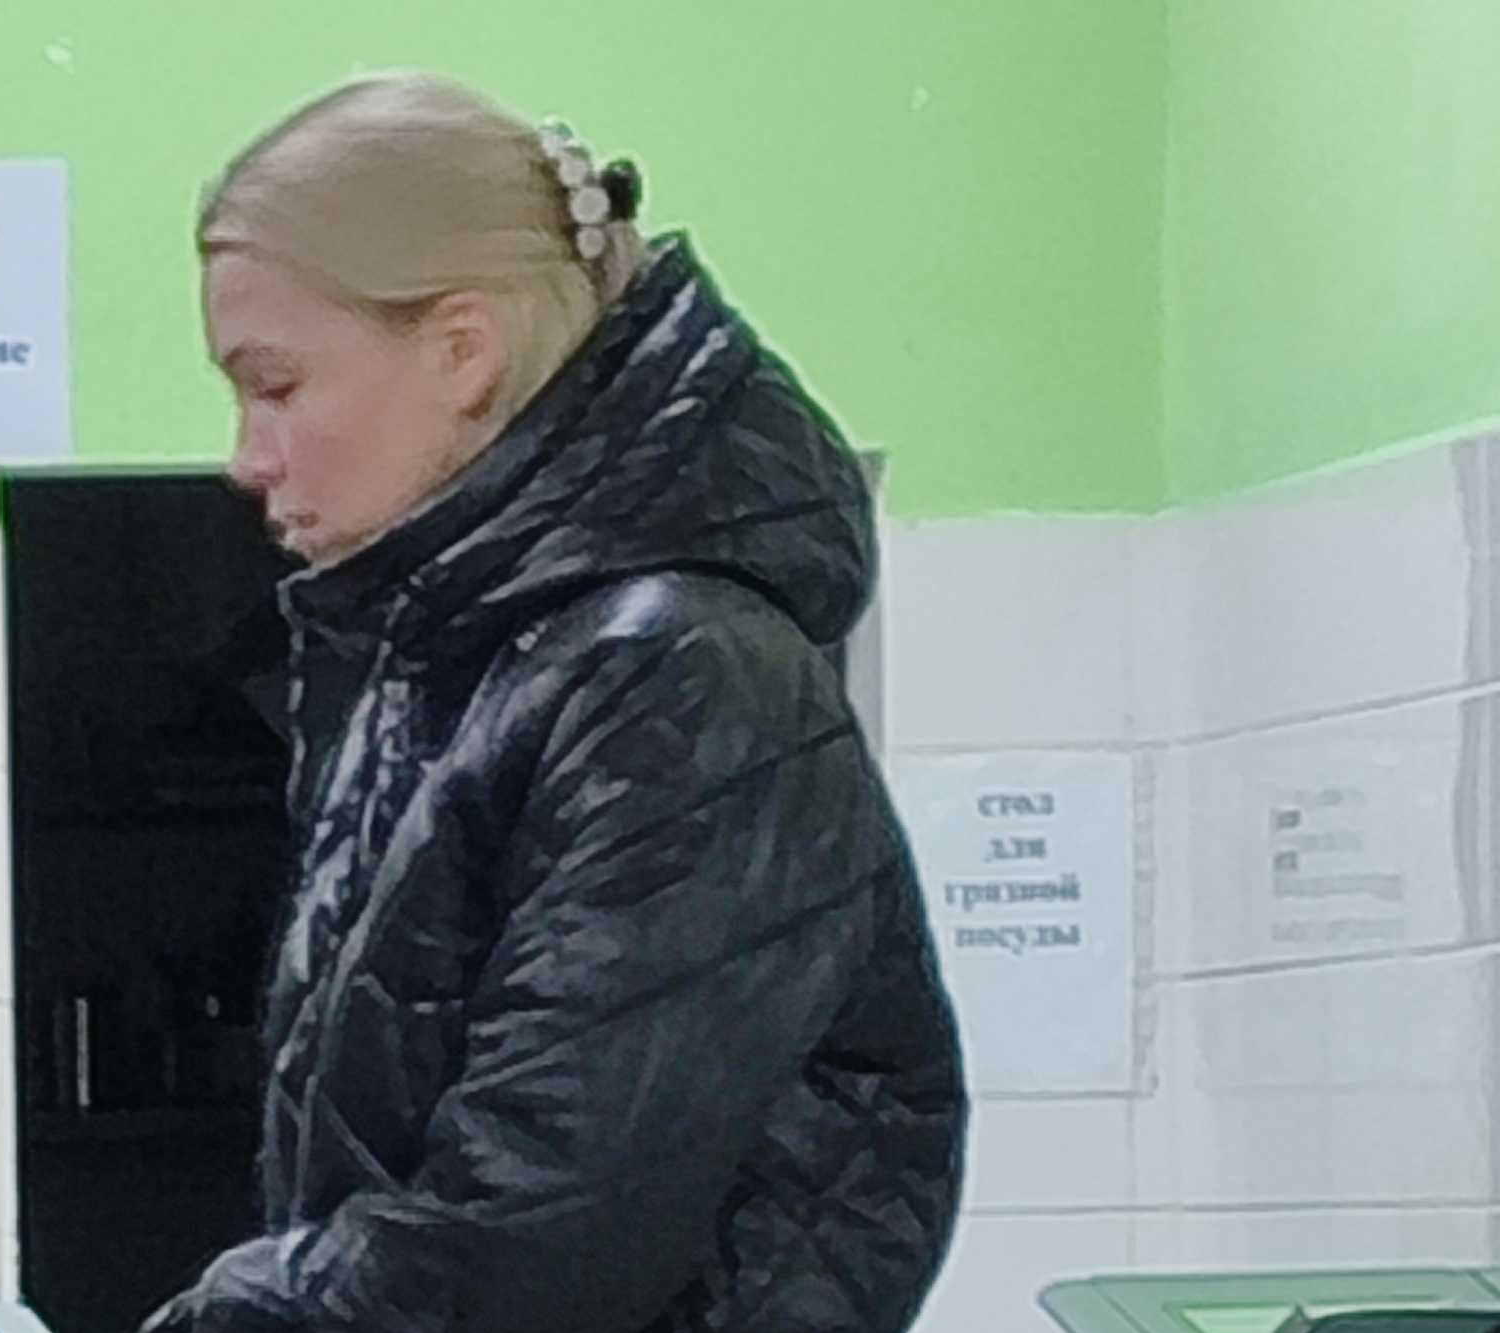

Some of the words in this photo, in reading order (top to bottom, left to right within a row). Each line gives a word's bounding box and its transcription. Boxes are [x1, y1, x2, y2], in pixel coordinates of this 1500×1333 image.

[977, 793, 1054, 818] стол
[984, 837, 1046, 863] для
[944, 873, 1081, 912] грязной
[955, 924, 1081, 956] посуды
